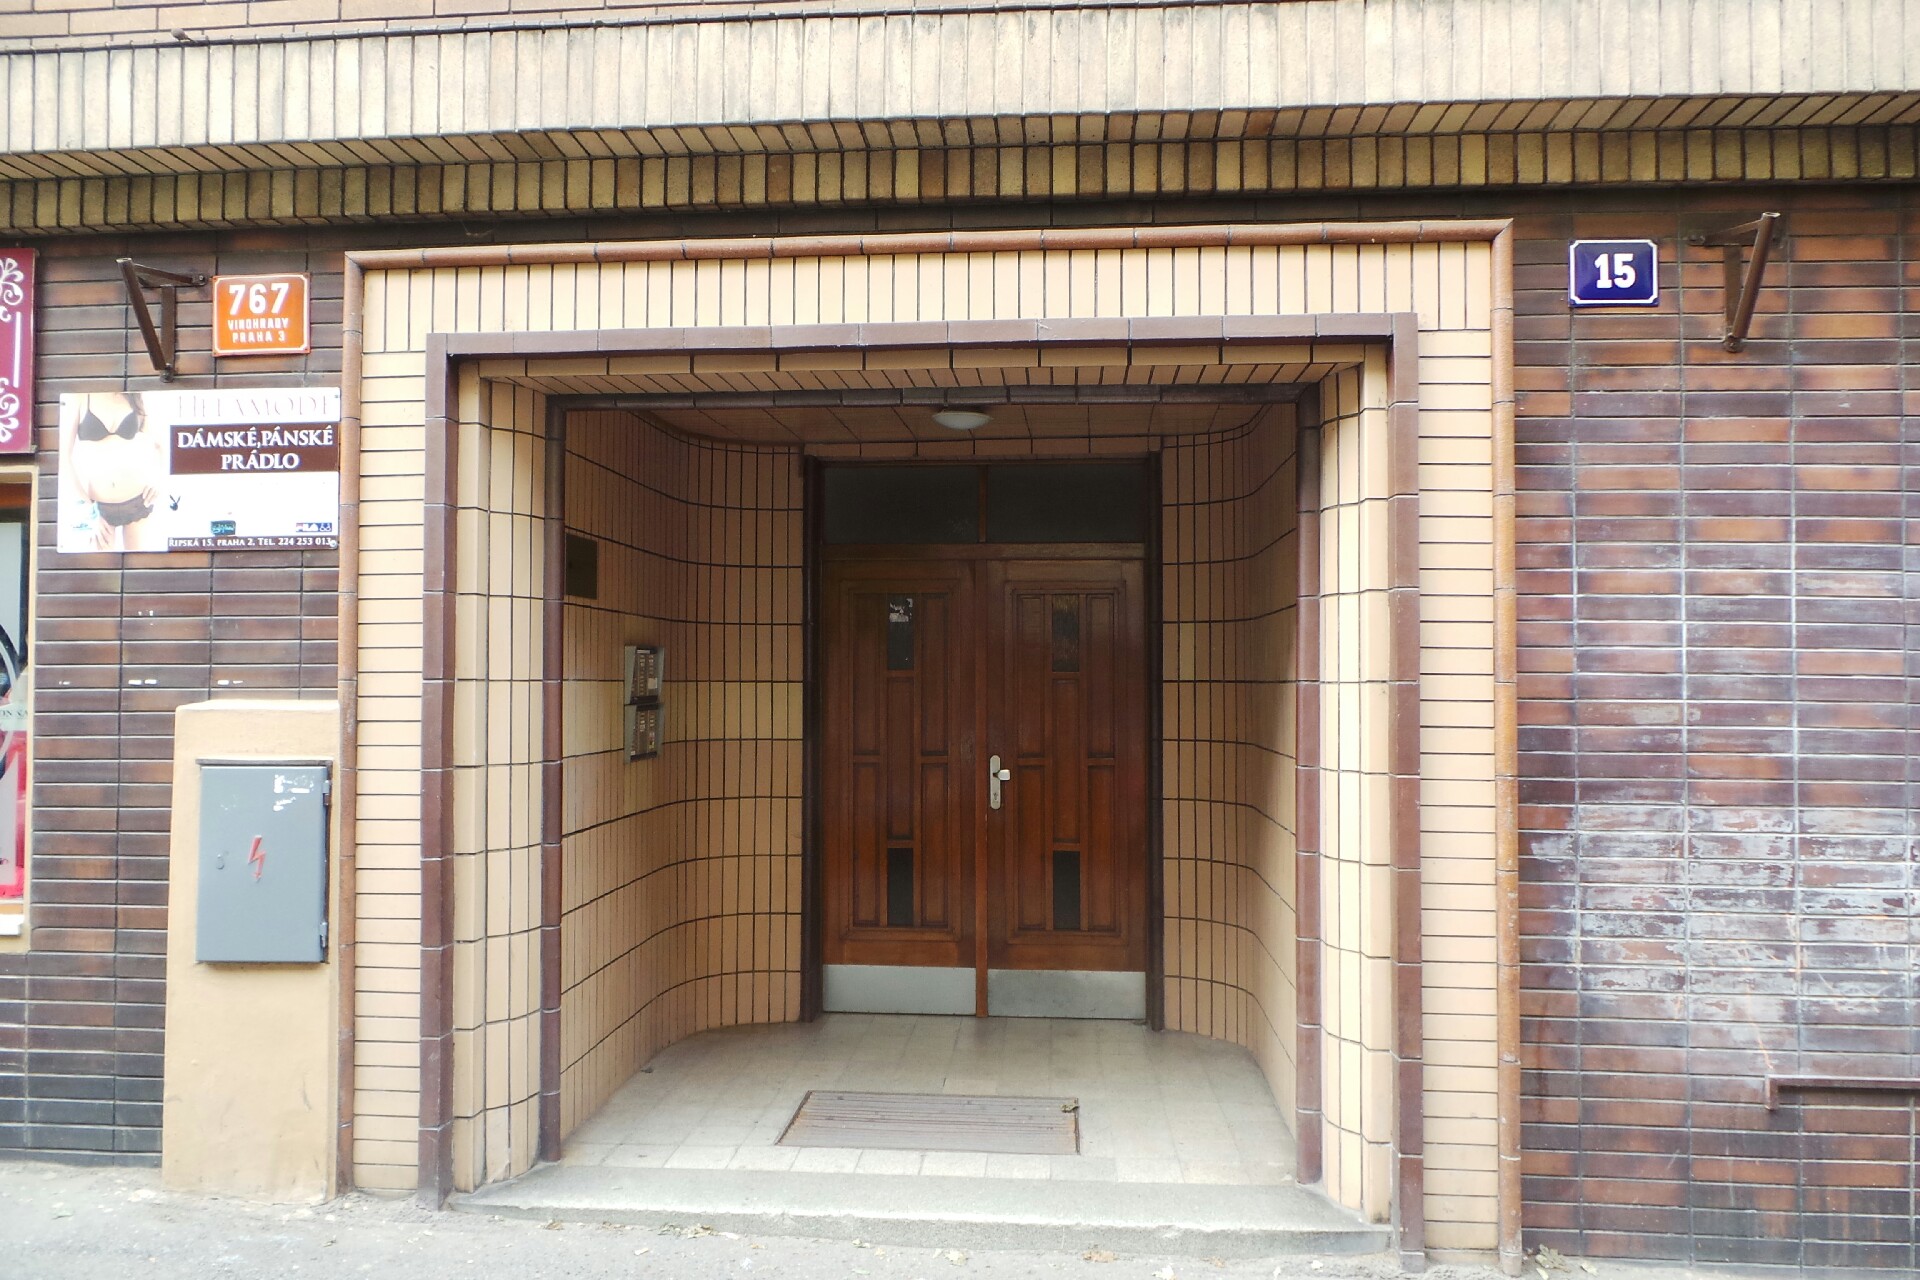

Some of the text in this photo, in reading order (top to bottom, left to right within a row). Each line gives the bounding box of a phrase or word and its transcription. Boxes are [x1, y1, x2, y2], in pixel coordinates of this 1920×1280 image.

[1594, 253, 1636, 289] 15
[229, 283, 289, 316] 767
[227, 318, 289, 330] VINOHRADY
[232, 331, 286, 343] PRAHA 3
[221, 450, 300, 470] PRÁDLO
[278, 537, 294, 546] 224
[296, 537, 313, 546] 253
[315, 537, 331, 546] 013
